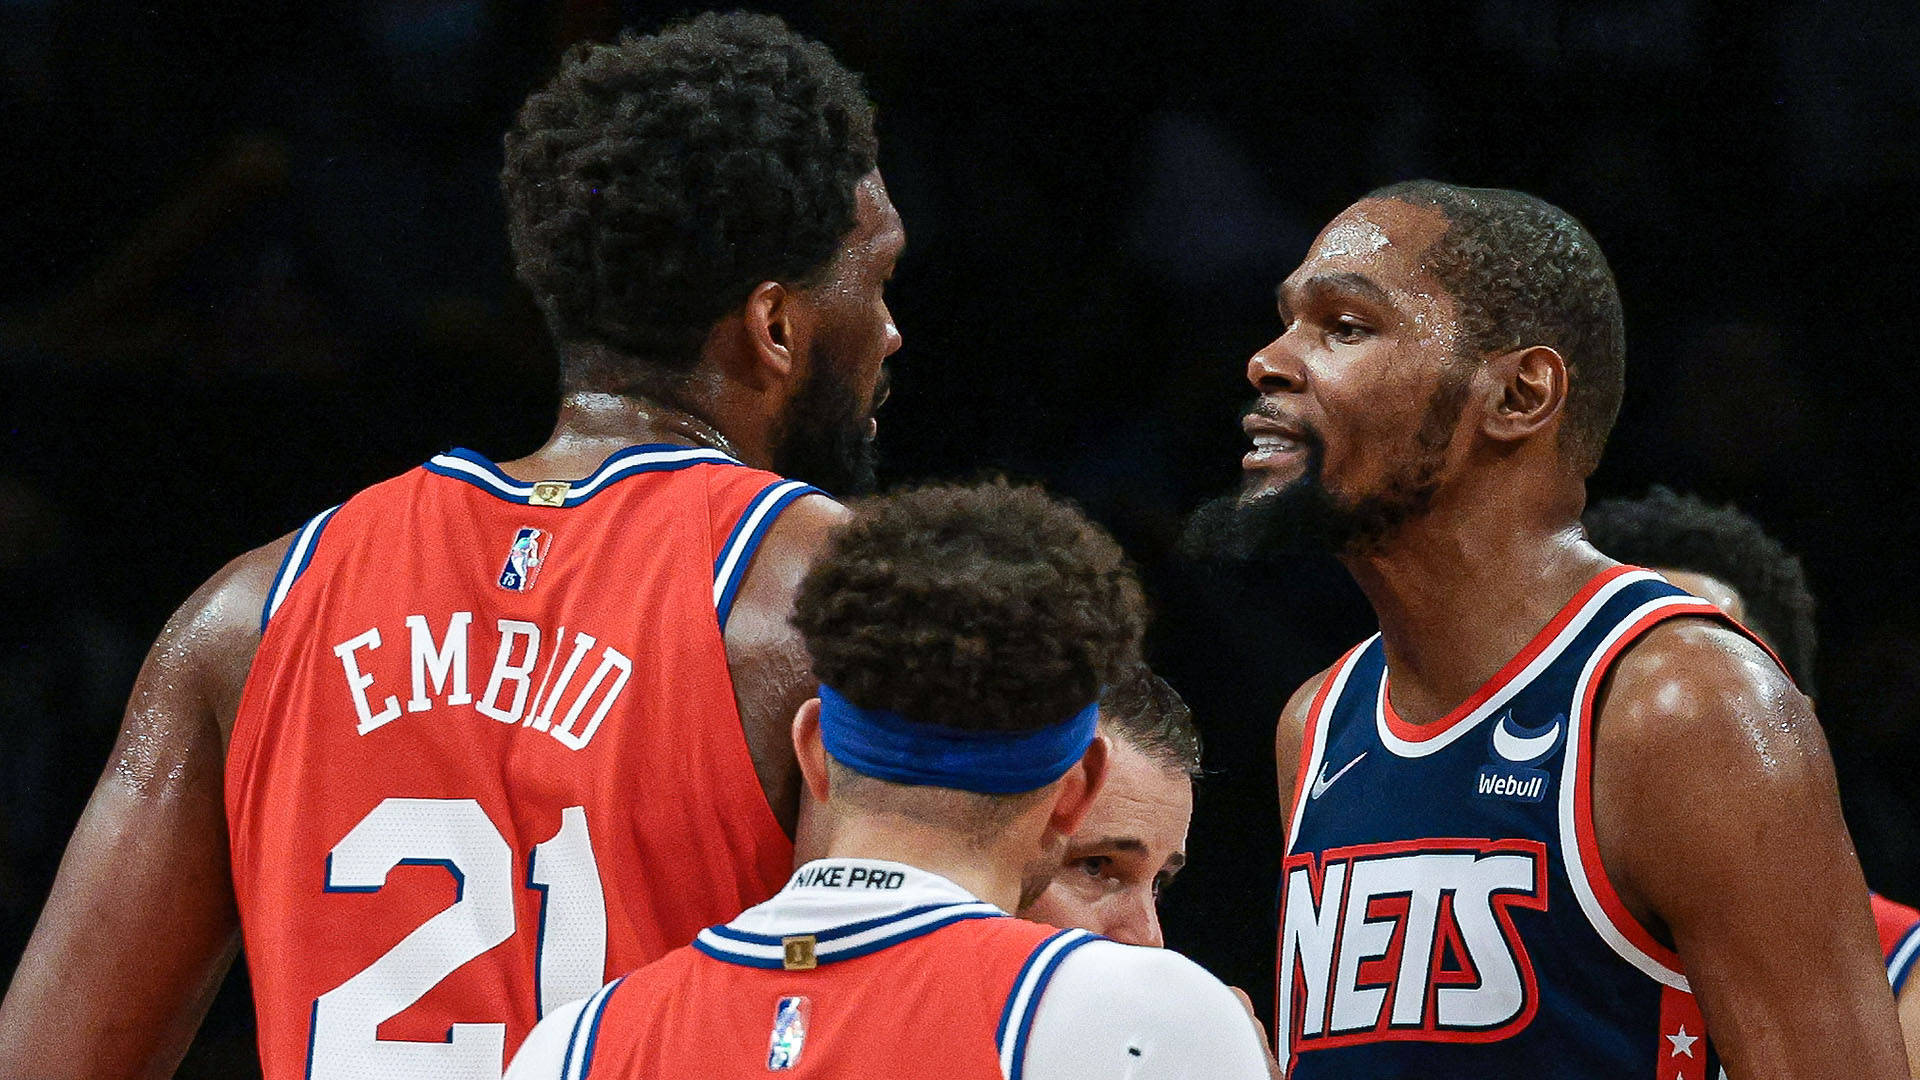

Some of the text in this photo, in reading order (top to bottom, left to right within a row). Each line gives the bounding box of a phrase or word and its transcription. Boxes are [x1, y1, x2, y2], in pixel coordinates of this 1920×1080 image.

[502, 572, 518, 586] 75
[1478, 773, 1542, 797] Webull
[793, 866, 905, 890] NIKE PRO
[305, 798, 609, 1080] 21
[1277, 852, 1535, 1077] NETS
